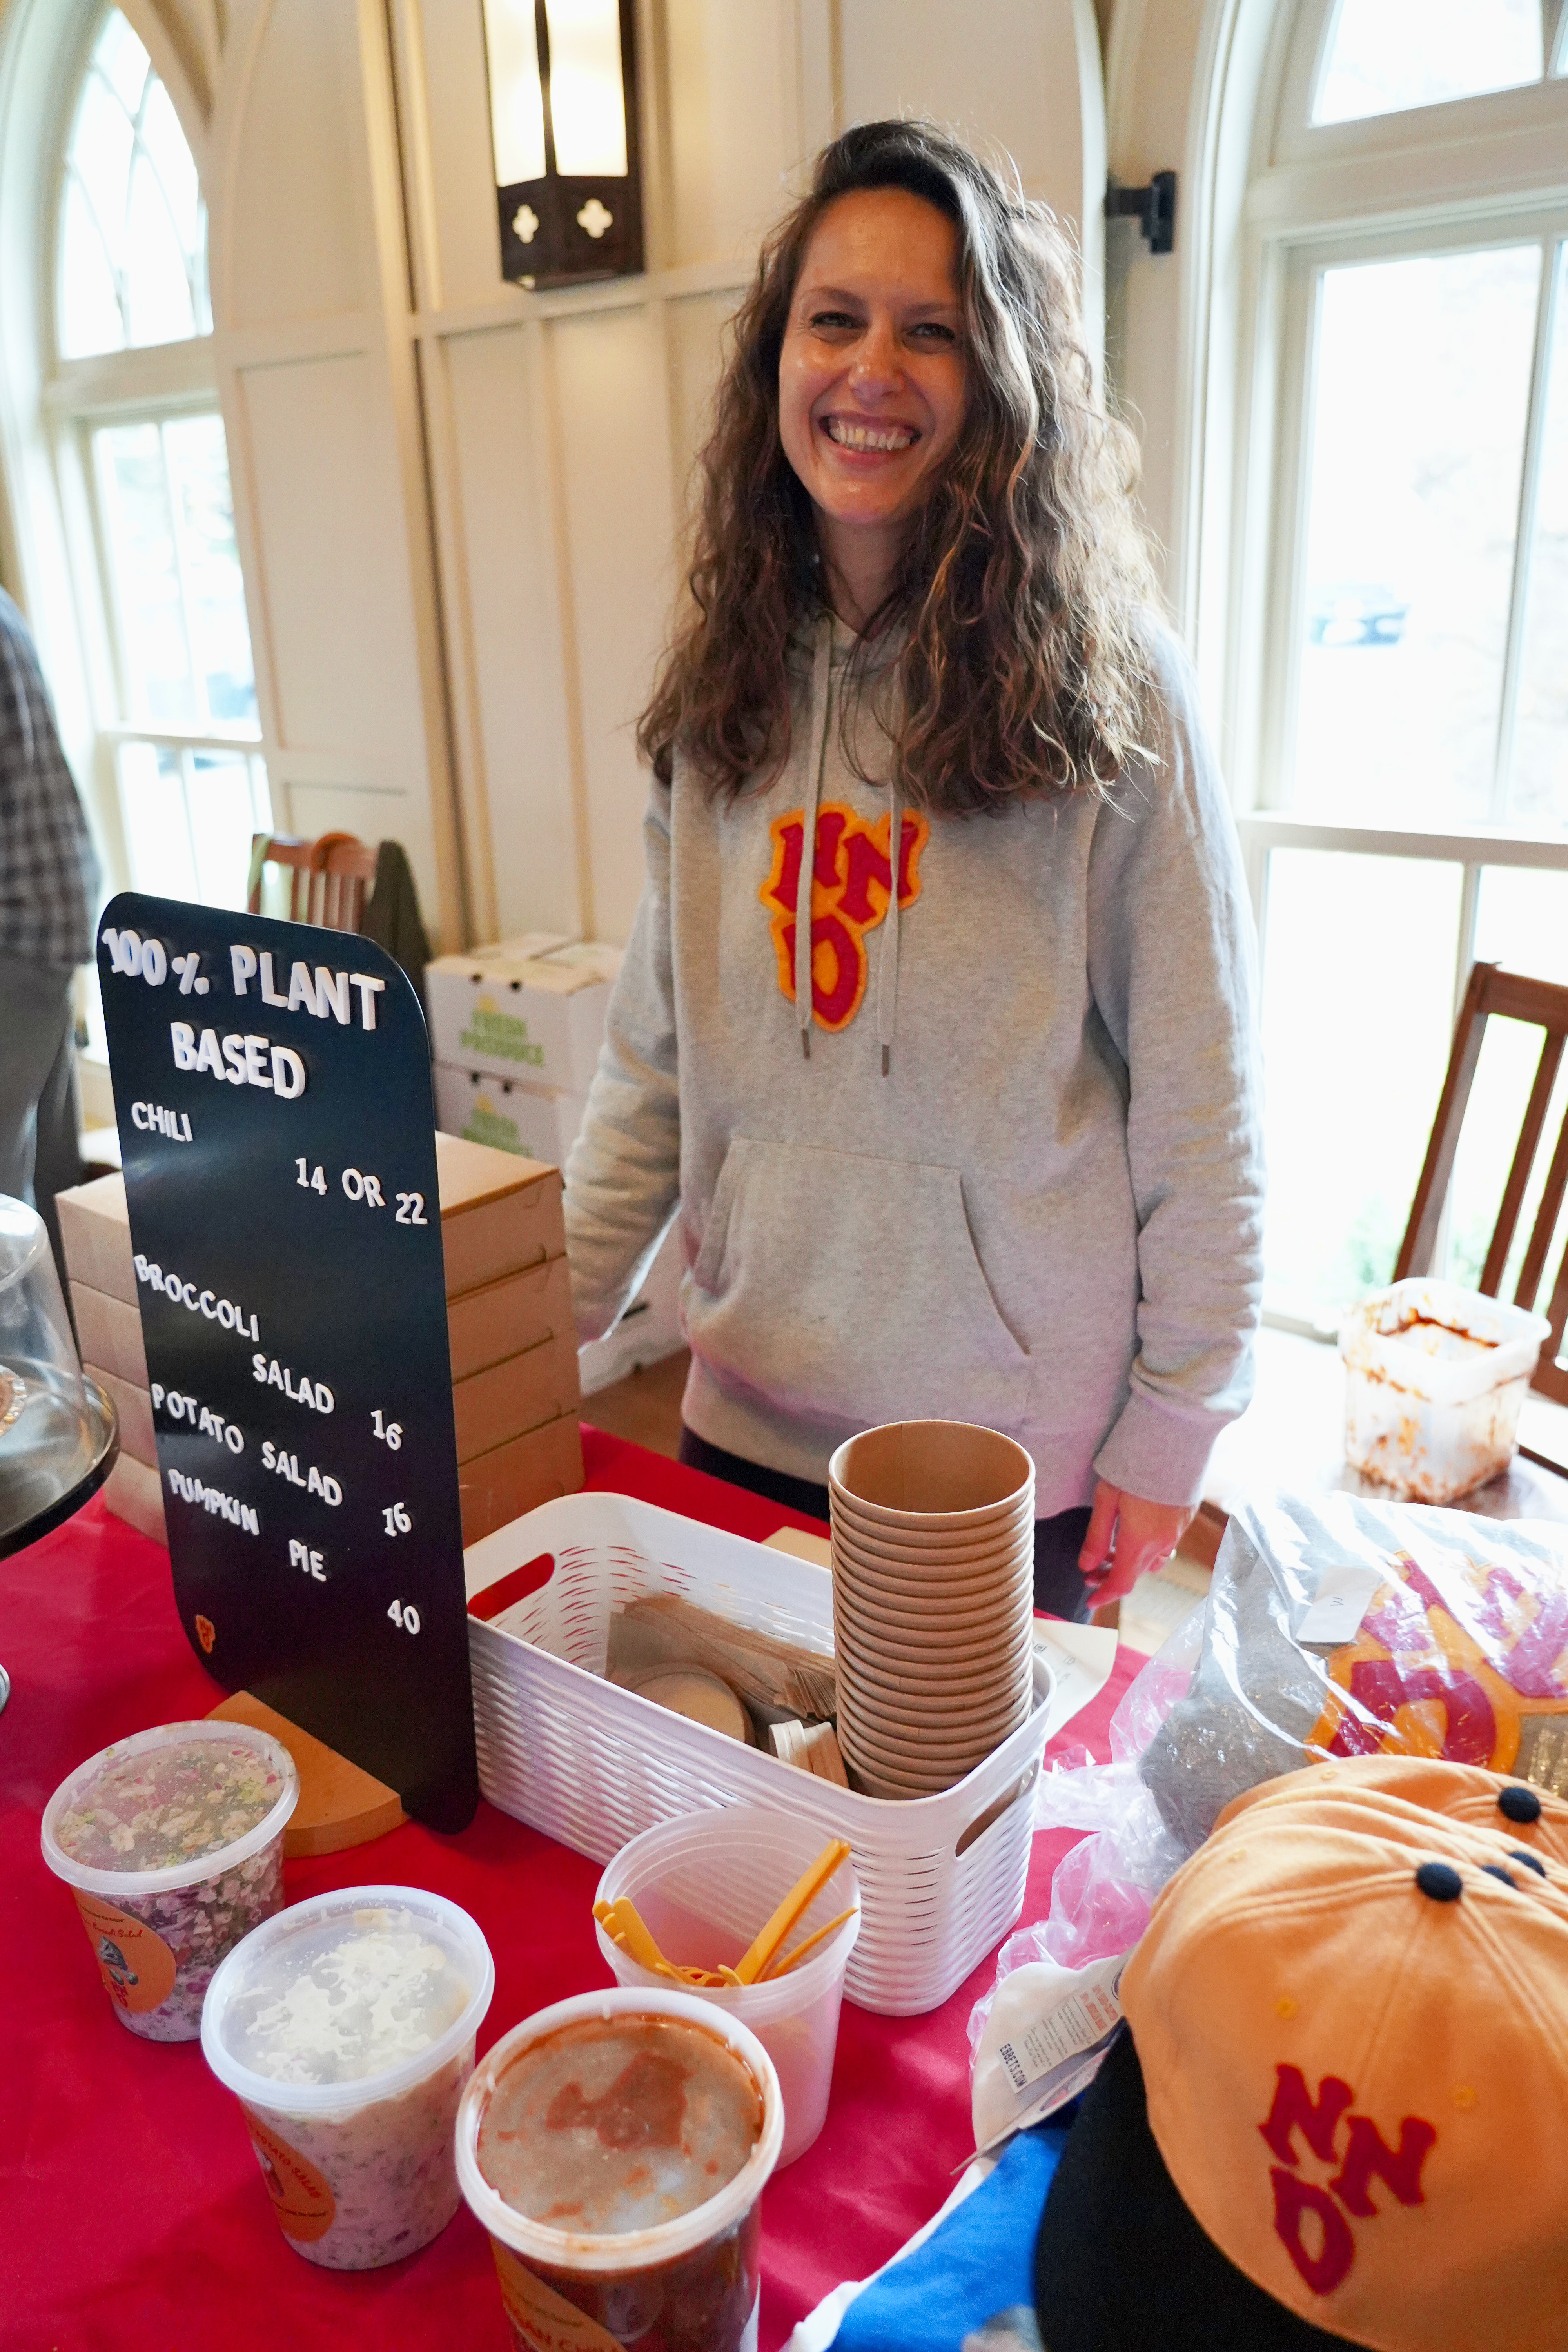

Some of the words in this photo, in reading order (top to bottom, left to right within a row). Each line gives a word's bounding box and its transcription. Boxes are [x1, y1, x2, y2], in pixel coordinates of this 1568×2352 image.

[102, 927, 211, 996] 100%
[229, 944, 385, 1031] PLANT
[170, 1021, 306, 1100] BASED
[131, 1101, 194, 1142] CHILI
[294, 1157, 328, 1196] 14
[341, 1167, 386, 1207] OR
[395, 1192, 428, 1225] 22
[134, 1254, 260, 1342] BROCCOLI
[252, 1353, 335, 1414] SALAD
[370, 1410, 403, 1451] 16
[151, 1383, 245, 1454] POTATO
[261, 1441, 343, 1507] SALAD
[381, 1502, 412, 1537] 16
[168, 1468, 260, 1535] PUMPKIN
[289, 1539, 327, 1582] PIE
[387, 1599, 421, 1635] 40
[1000, 2043, 1027, 2087] EBBETS.COM
